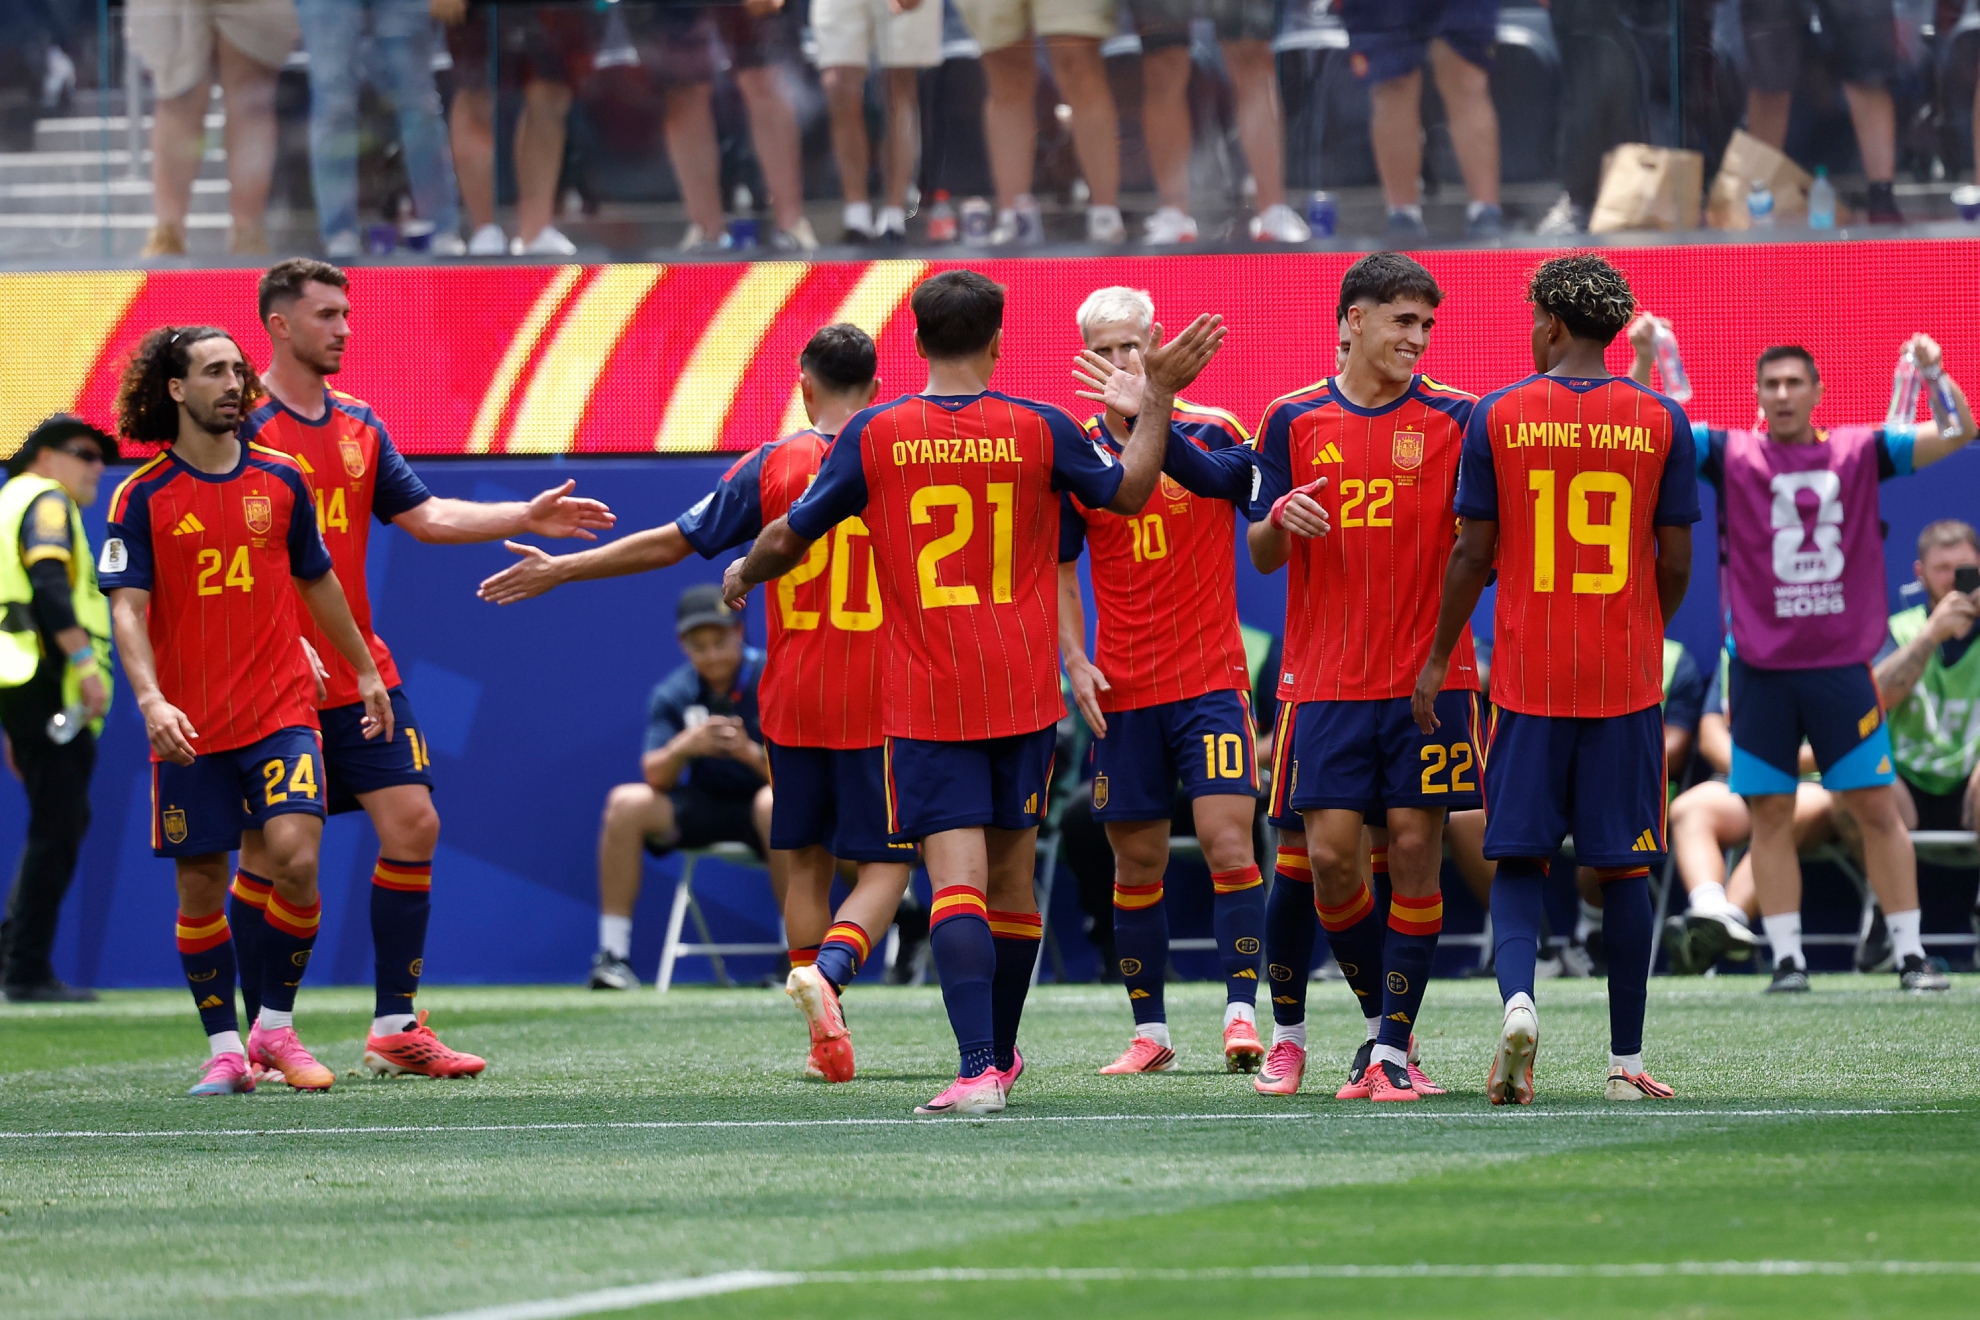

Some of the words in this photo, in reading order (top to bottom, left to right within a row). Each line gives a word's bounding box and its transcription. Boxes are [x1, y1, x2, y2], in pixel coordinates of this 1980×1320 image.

[893, 437, 1023, 466] OYARZABAL
[1504, 421, 1582, 449] LAMINE
[1589, 423, 1655, 454] YAMAL
[315, 487, 349, 534] 14
[1340, 478, 1394, 528] 22
[910, 482, 1014, 610] 21
[1127, 513, 1168, 563] 10
[1528, 469, 1632, 595] 19
[198, 545, 255, 596] 24
[777, 515, 884, 632] 20
[1776, 594, 1846, 618] 2026
[263, 753, 318, 806] 24
[1202, 733, 1244, 779] 10
[1420, 742, 1475, 794] 22
